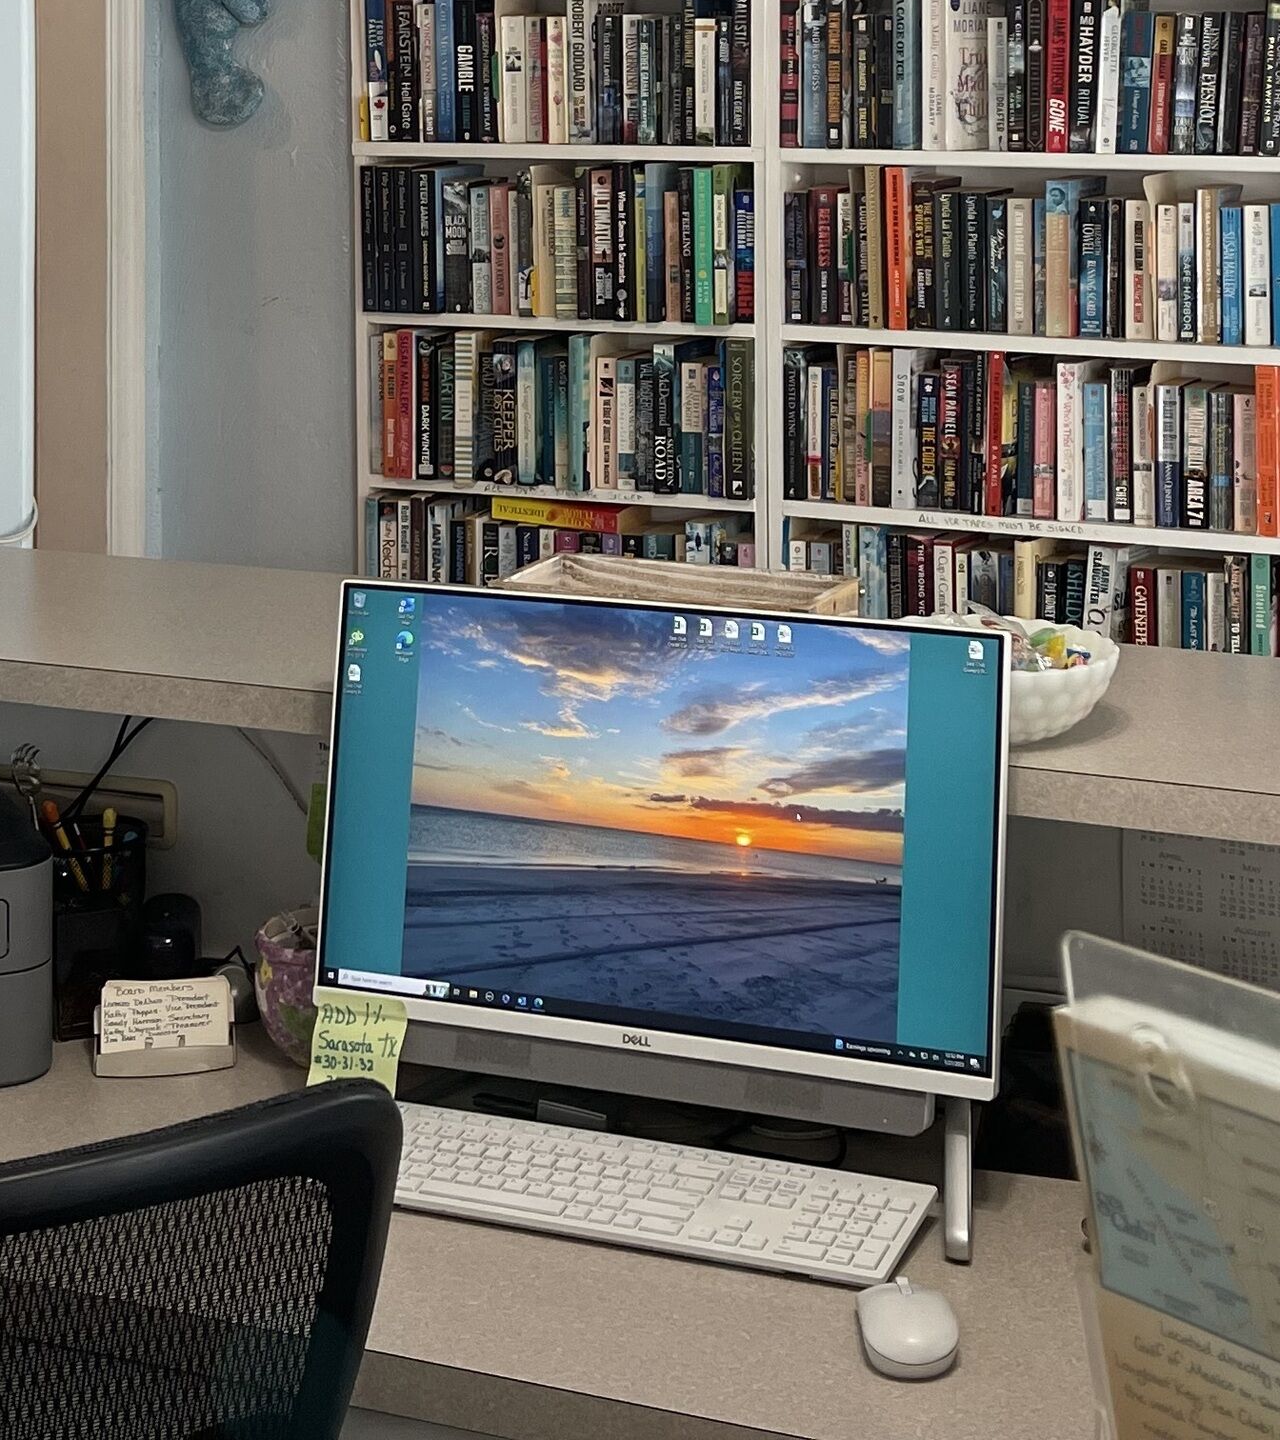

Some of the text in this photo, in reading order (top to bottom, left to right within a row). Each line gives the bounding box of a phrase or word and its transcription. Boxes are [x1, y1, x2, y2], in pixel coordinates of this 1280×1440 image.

[963, 1, 991, 15] LIANE
[457, 45, 474, 92] GAMBLE
[572, 0, 585, 92] ROBERT GODDARD
[1078, 27, 1093, 126] HAYDER RITUAL
[403, 82, 412, 131] Hell Gate
[1049, 98, 1065, 136] GONE
[445, 216, 466, 226] BLACK
[446, 227, 467, 237] MOON
[681, 210, 691, 257] FEELING
[1082, 223, 1095, 255] LOWELL
[1182, 285, 1191, 331] HARBOR
[502, 388, 515, 450] KEEPER
[732, 356, 742, 475] SORCERY QUEEN
[945, 371, 956, 439] SEAN PARNELL
[421, 405, 430, 466] DARK WINTER
[654, 435, 667, 481] ROAD
[922, 427, 935, 477] THE CODEX
[1187, 478, 1204, 509] AREA
[1101, 564, 1109, 594] KARIN
[322, 1006, 357, 1025] ADD
[318, 1031, 373, 1055] Sarasota
[621, 1033, 651, 1048] DELL
